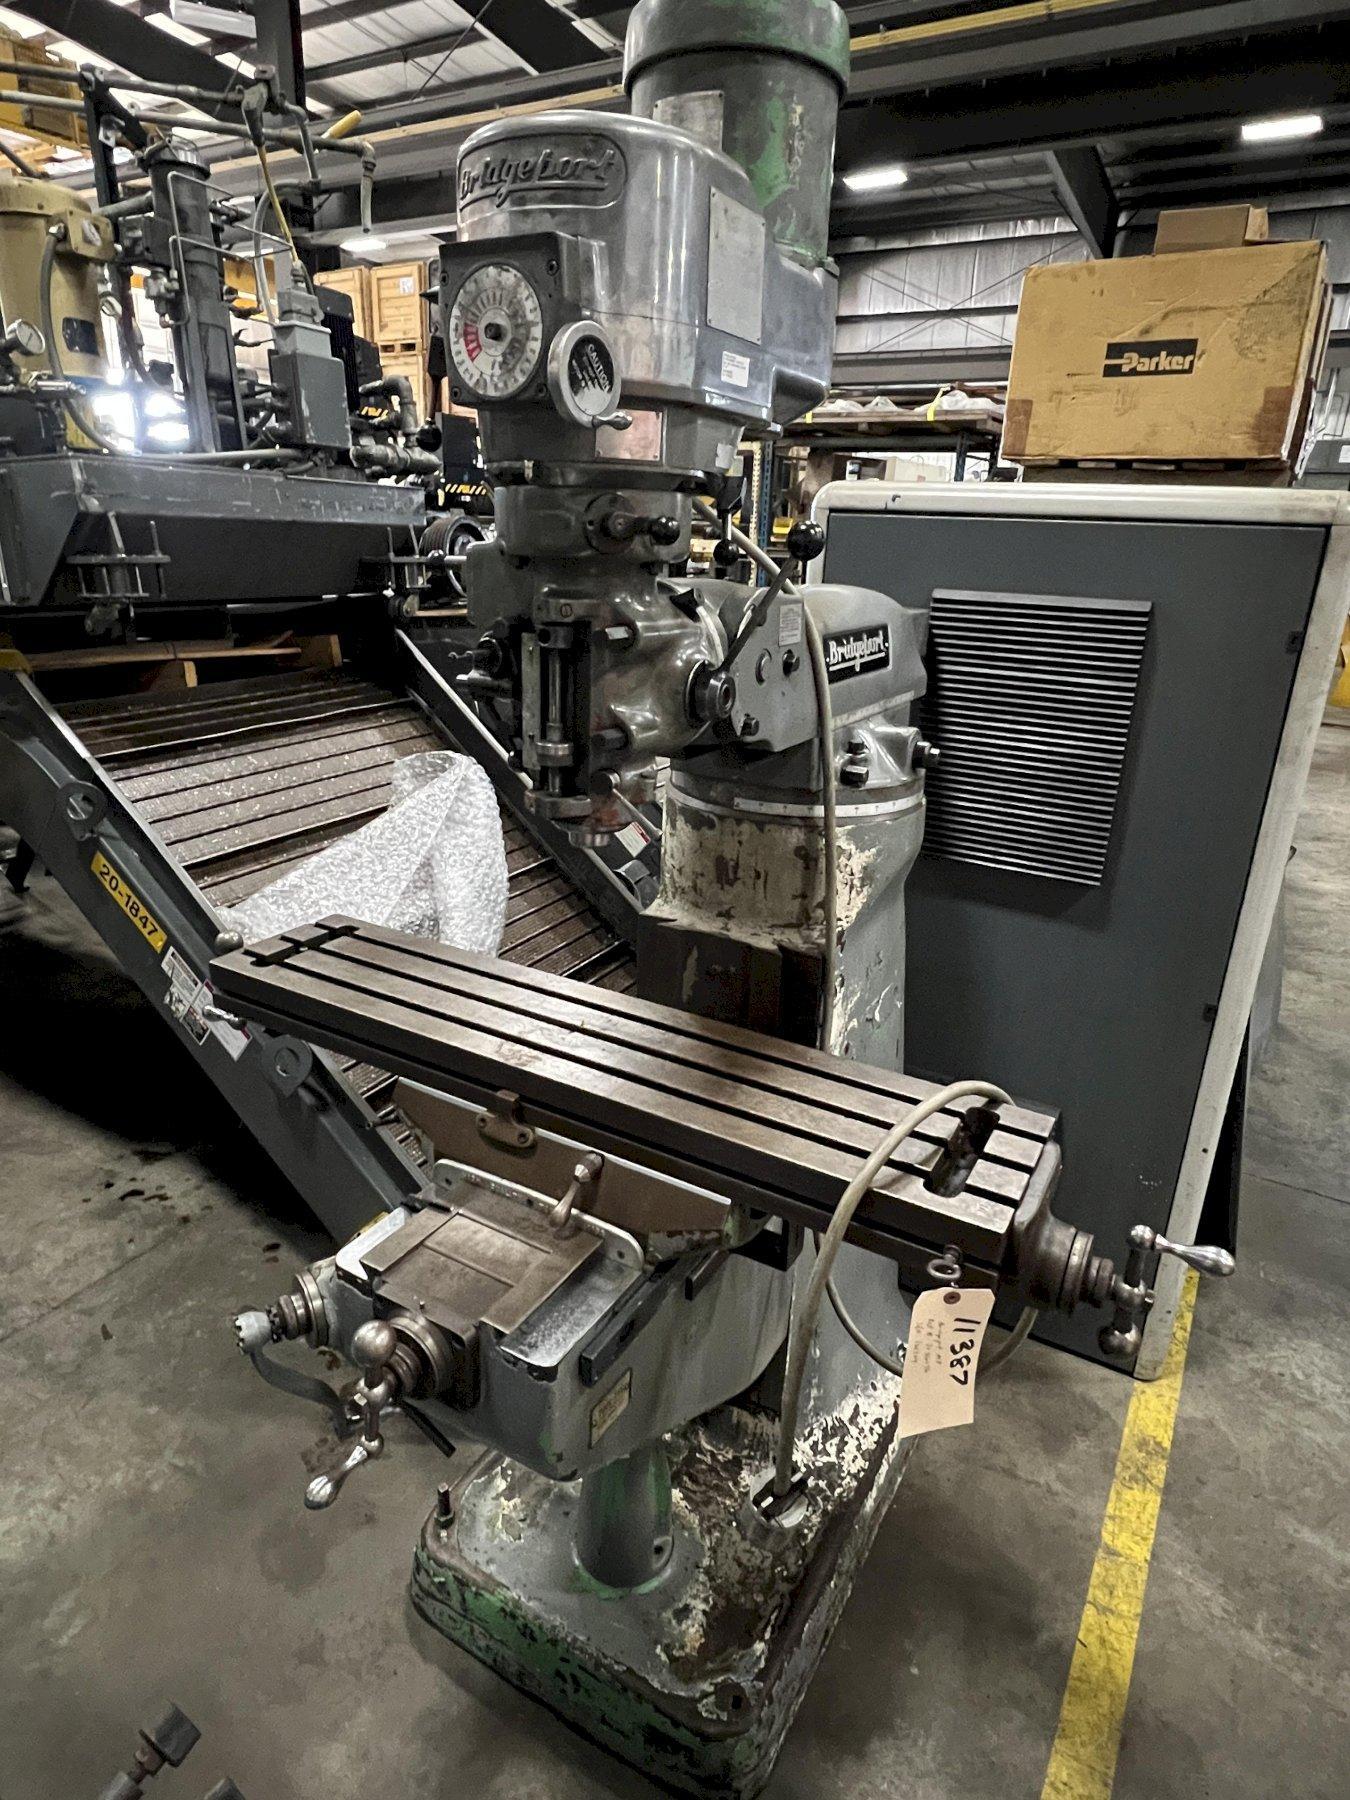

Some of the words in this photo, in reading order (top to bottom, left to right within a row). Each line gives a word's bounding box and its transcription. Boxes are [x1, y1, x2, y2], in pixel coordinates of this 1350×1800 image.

[460, 149, 615, 209] Bridgeport
[587, 343, 611, 393] CAUTION
[1121, 350, 1194, 373] Parker
[829, 630, 887, 672] Bridgeport
[99, 864, 158, 937] 20-1847
[949, 1317, 982, 1386] 11387
